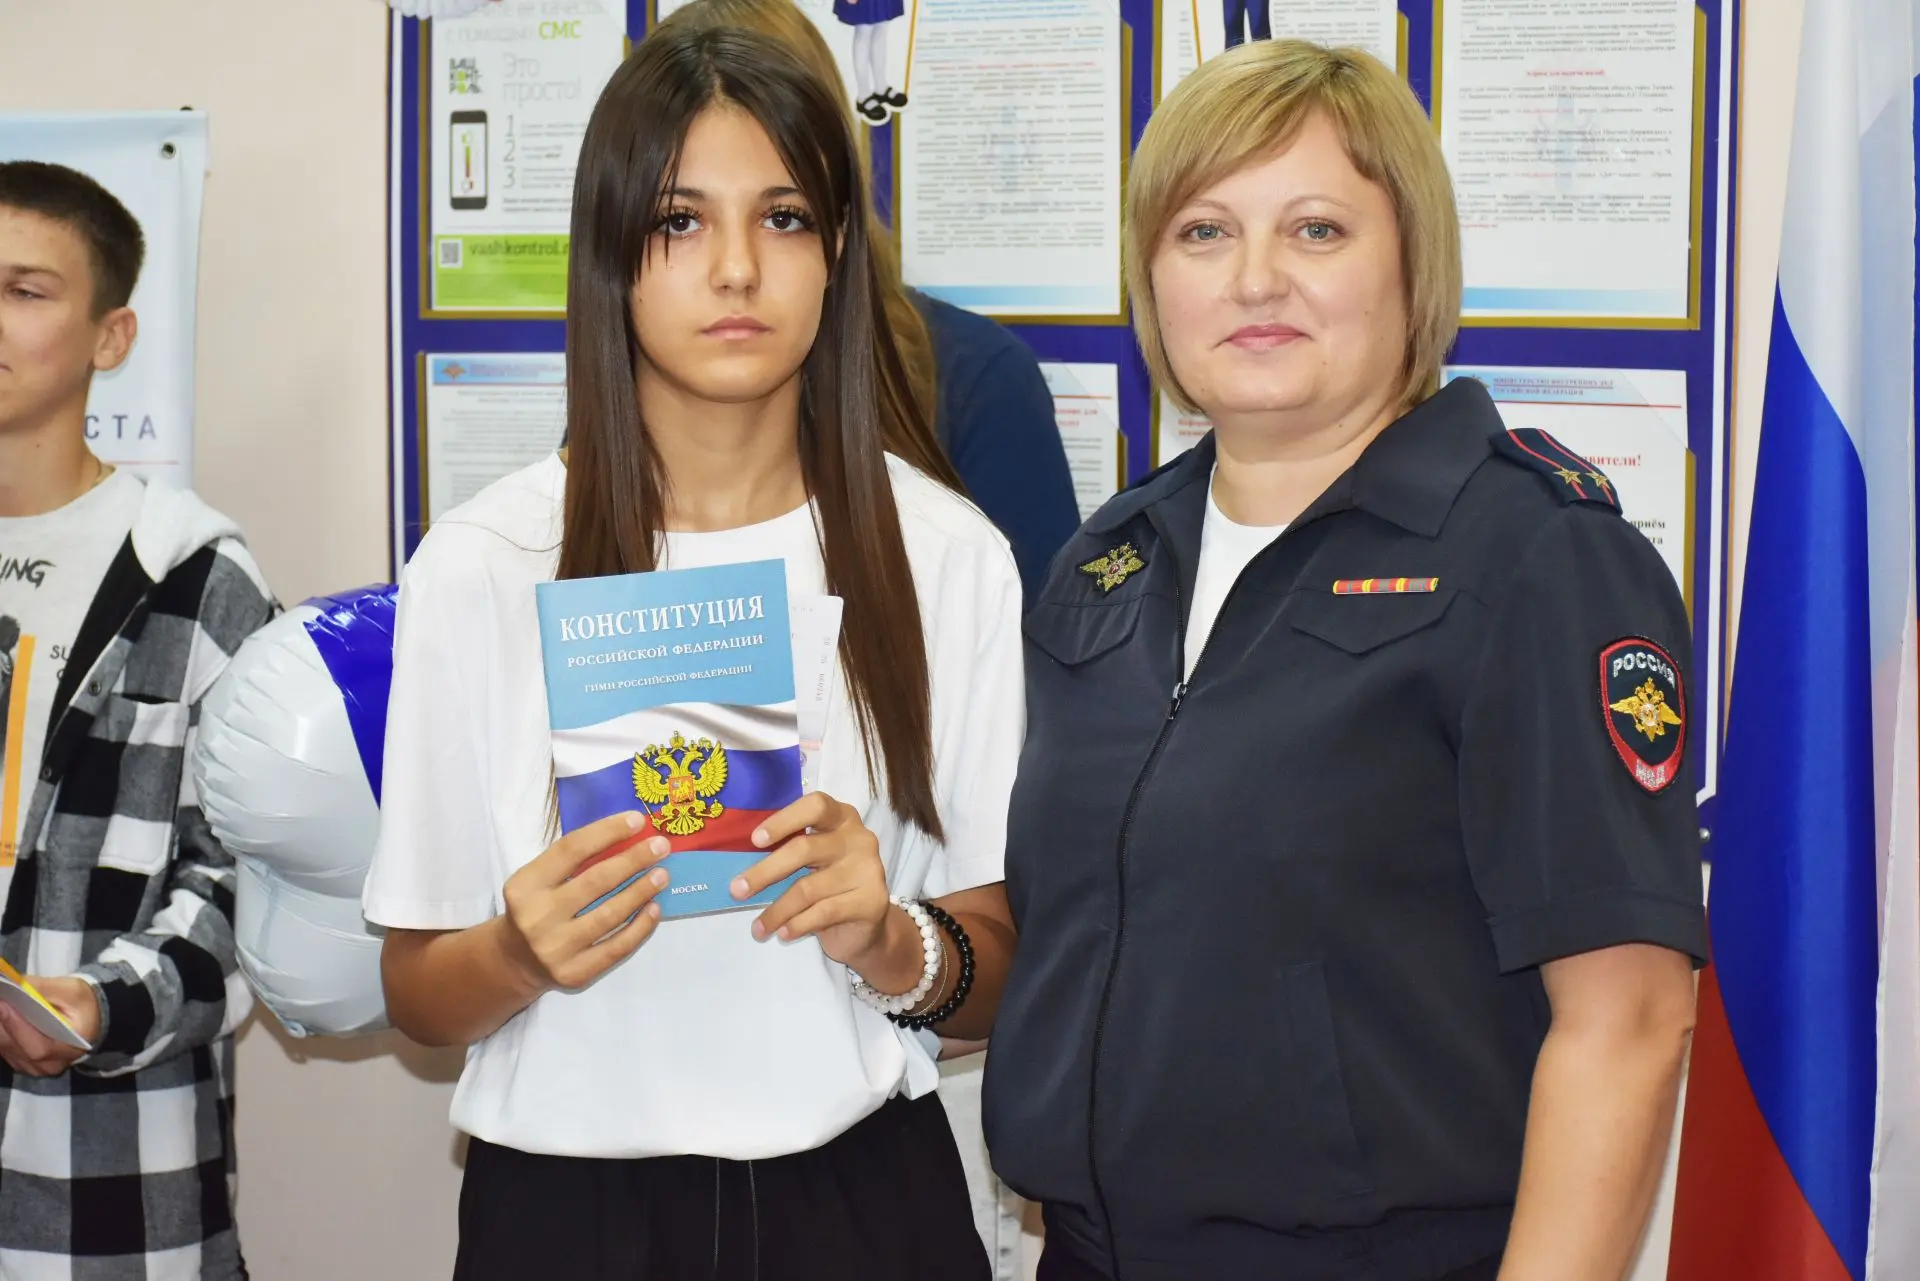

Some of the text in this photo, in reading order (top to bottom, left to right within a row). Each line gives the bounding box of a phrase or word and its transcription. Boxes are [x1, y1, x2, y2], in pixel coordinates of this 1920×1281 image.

[538, 20, 582, 40] СМС
[502, 52, 540, 78] Это
[502, 75, 582, 106] просто!
[505, 115, 515, 137] 1
[503, 140, 516, 162] 2
[503, 165, 516, 189] 3
[560, 594, 765, 642] КОНСТИТУЦИЯ
[567, 634, 763, 668] РОССИЙСКОЙ ФЕДЕРАЦИИ
[585, 665, 753, 693] ГИМН РОССИЙСКОЙ ФЕДЕРАЦИИ
[1613, 652, 1676, 689] РОССИЯ
[671, 883, 709, 895] МОСКВА
